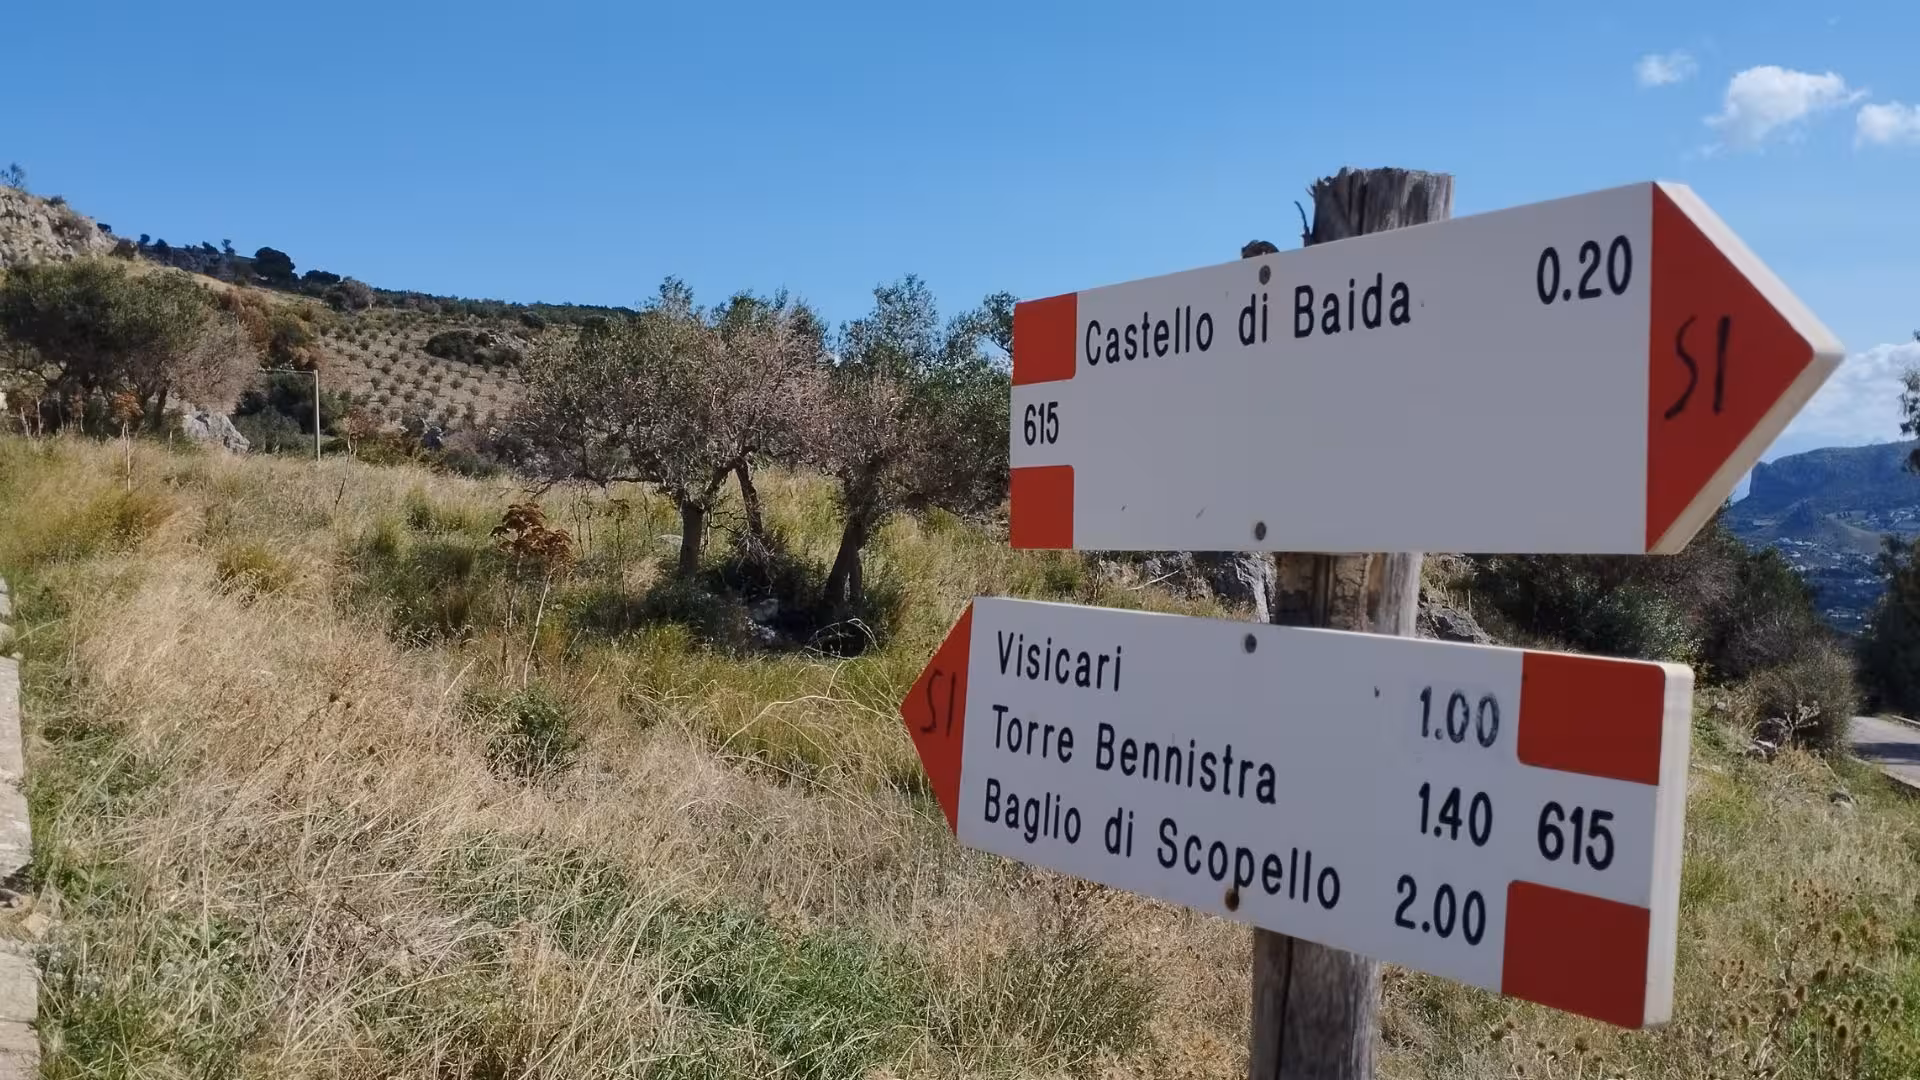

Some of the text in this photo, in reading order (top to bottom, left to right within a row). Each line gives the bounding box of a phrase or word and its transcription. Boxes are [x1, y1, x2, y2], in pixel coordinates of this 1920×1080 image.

[1536, 235, 1633, 305] 0.20
[1086, 272, 1411, 366] Castello di Baida
[1023, 401, 1059, 446] 615
[997, 630, 1122, 692] Visicari
[1419, 686, 1500, 748] 1.00
[992, 704, 1277, 805] Torre Bennistra
[984, 777, 1341, 910] Baglio di Scopello
[1418, 782, 1493, 847] 1.40
[1537, 801, 1615, 871] 615
[1394, 874, 1486, 946] 2.00
